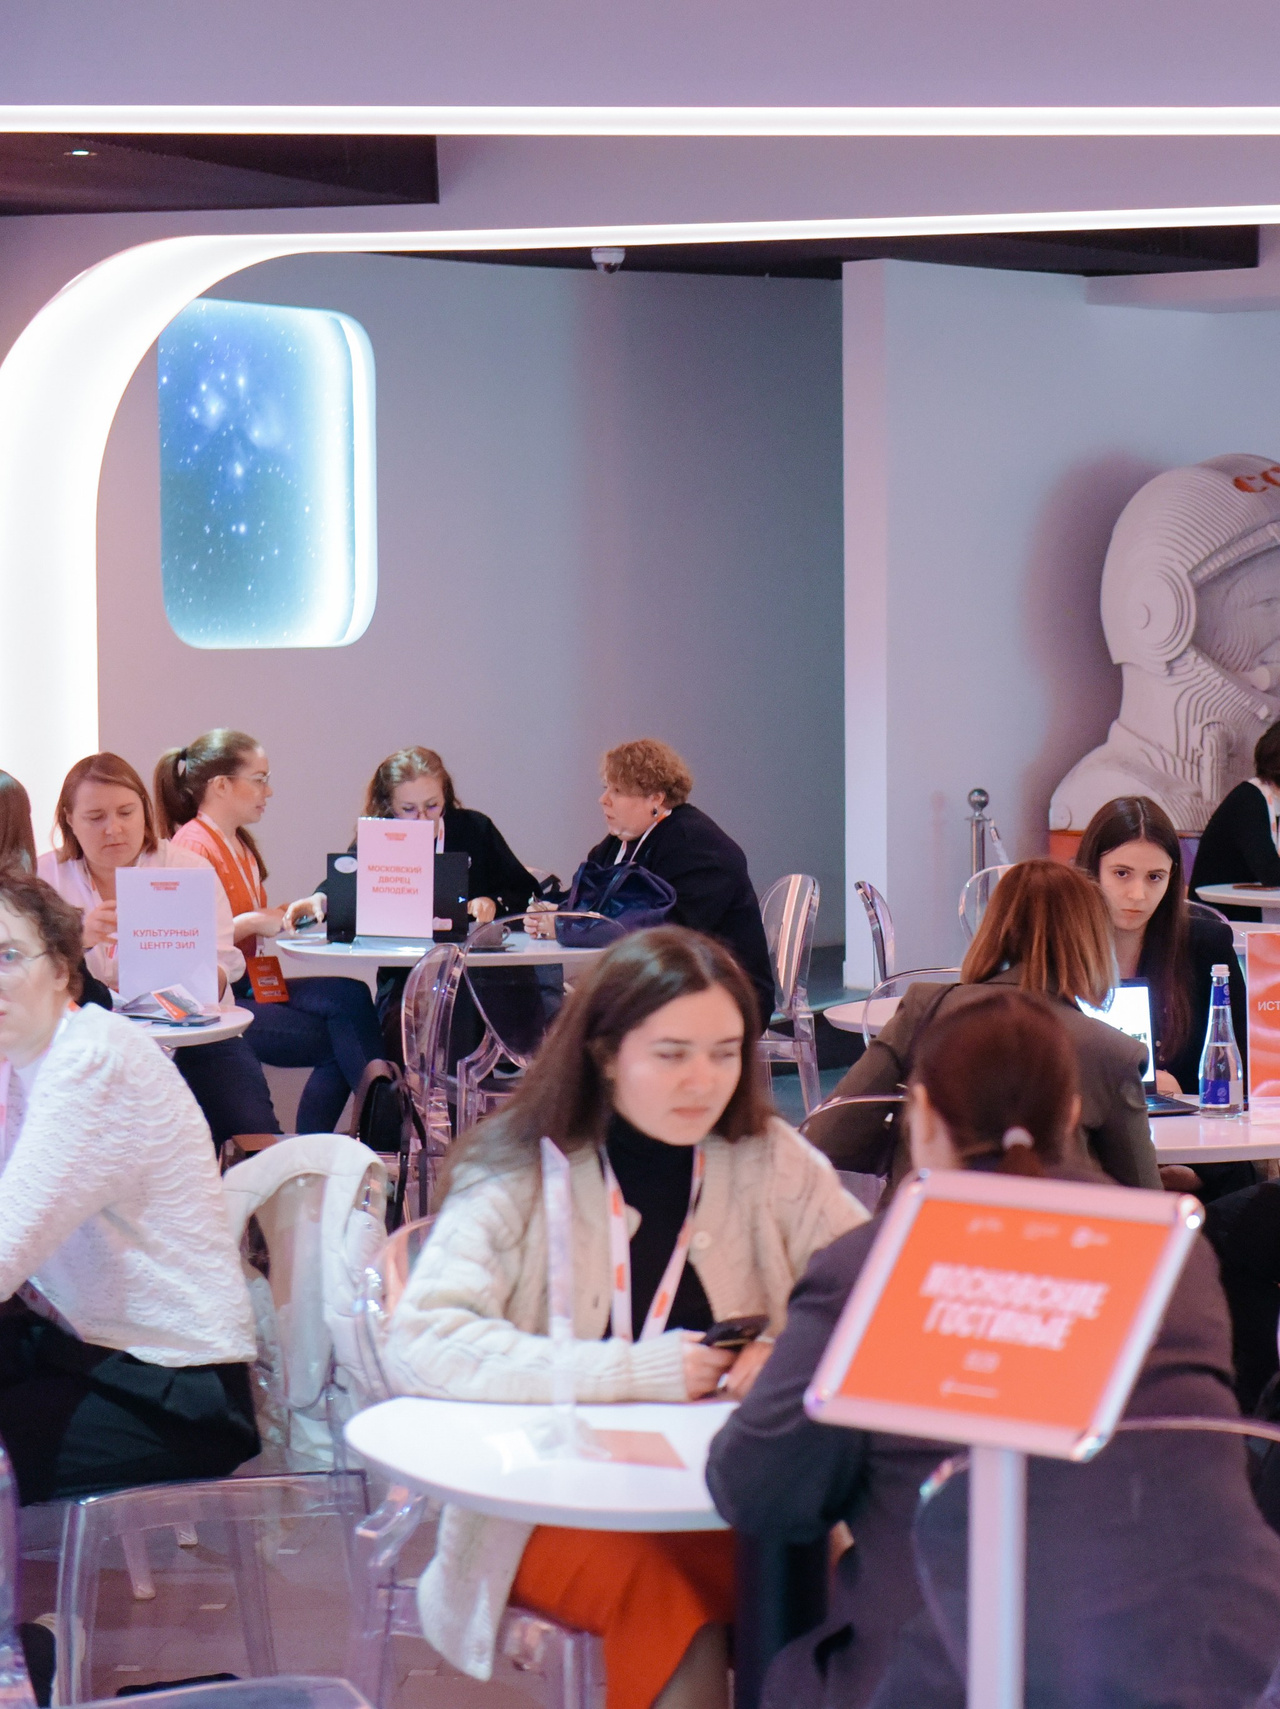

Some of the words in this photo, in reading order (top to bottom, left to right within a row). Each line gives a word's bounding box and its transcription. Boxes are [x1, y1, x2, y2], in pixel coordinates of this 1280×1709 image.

[368, 864, 422, 875] МОСКОВСКИЙ
[378, 876, 411, 885] ДВОРЕЦ
[132, 927, 200, 937] КУЛЬТУРНЫЙ
[139, 941, 173, 951] ЦЕНТР
[175, 941, 196, 949] ЗИЛ
[919, 1261, 1110, 1321] МОСКОВСКИЕ
[922, 1297, 1075, 1352] ГОСТИНЫЕ
